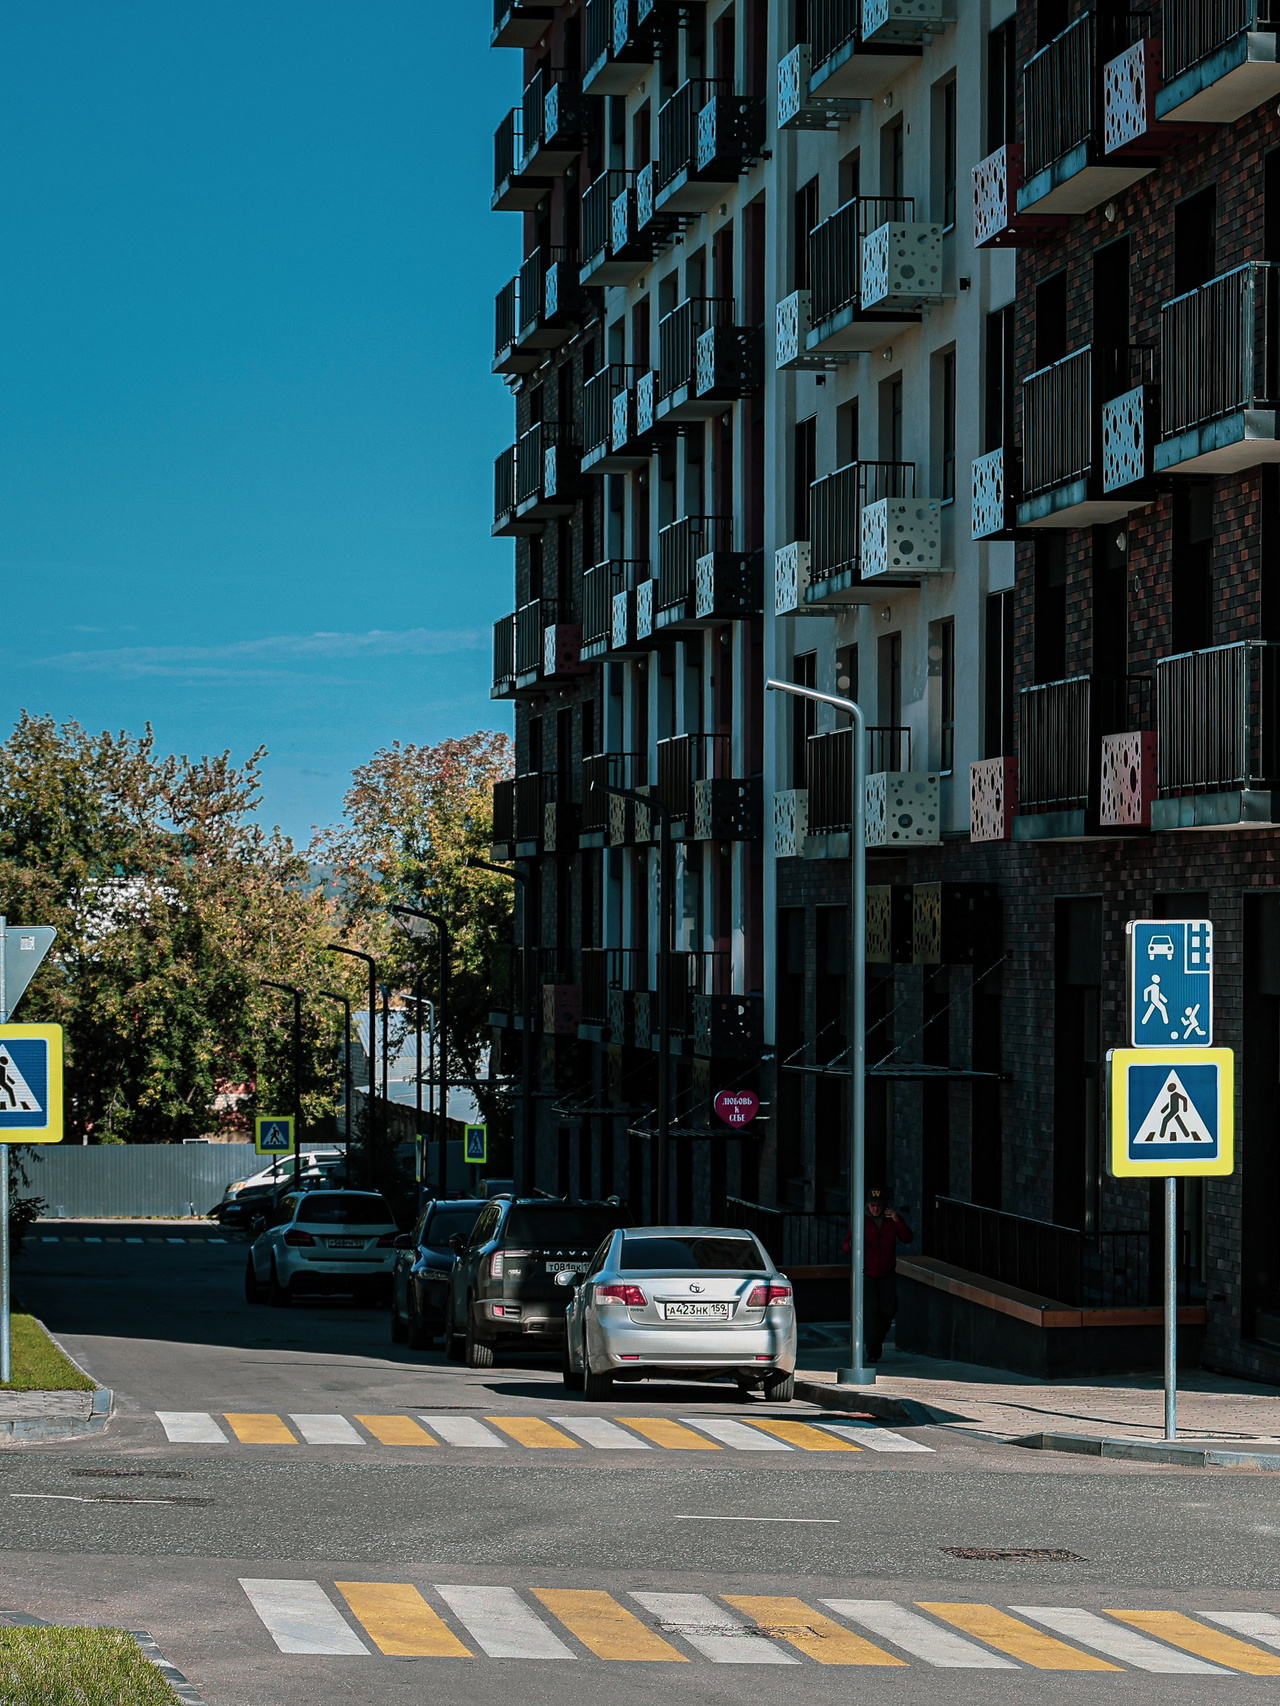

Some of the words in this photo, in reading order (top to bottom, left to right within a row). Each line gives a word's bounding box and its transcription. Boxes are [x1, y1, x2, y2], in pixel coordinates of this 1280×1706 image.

[722, 1097, 752, 1105] ЛЮБОВЬ
[734, 1105, 740, 1113] К
[729, 1113, 746, 1122] СЕБЕ
[669, 1304, 708, 1315] А423НК
[711, 1303, 726, 1312] 159
